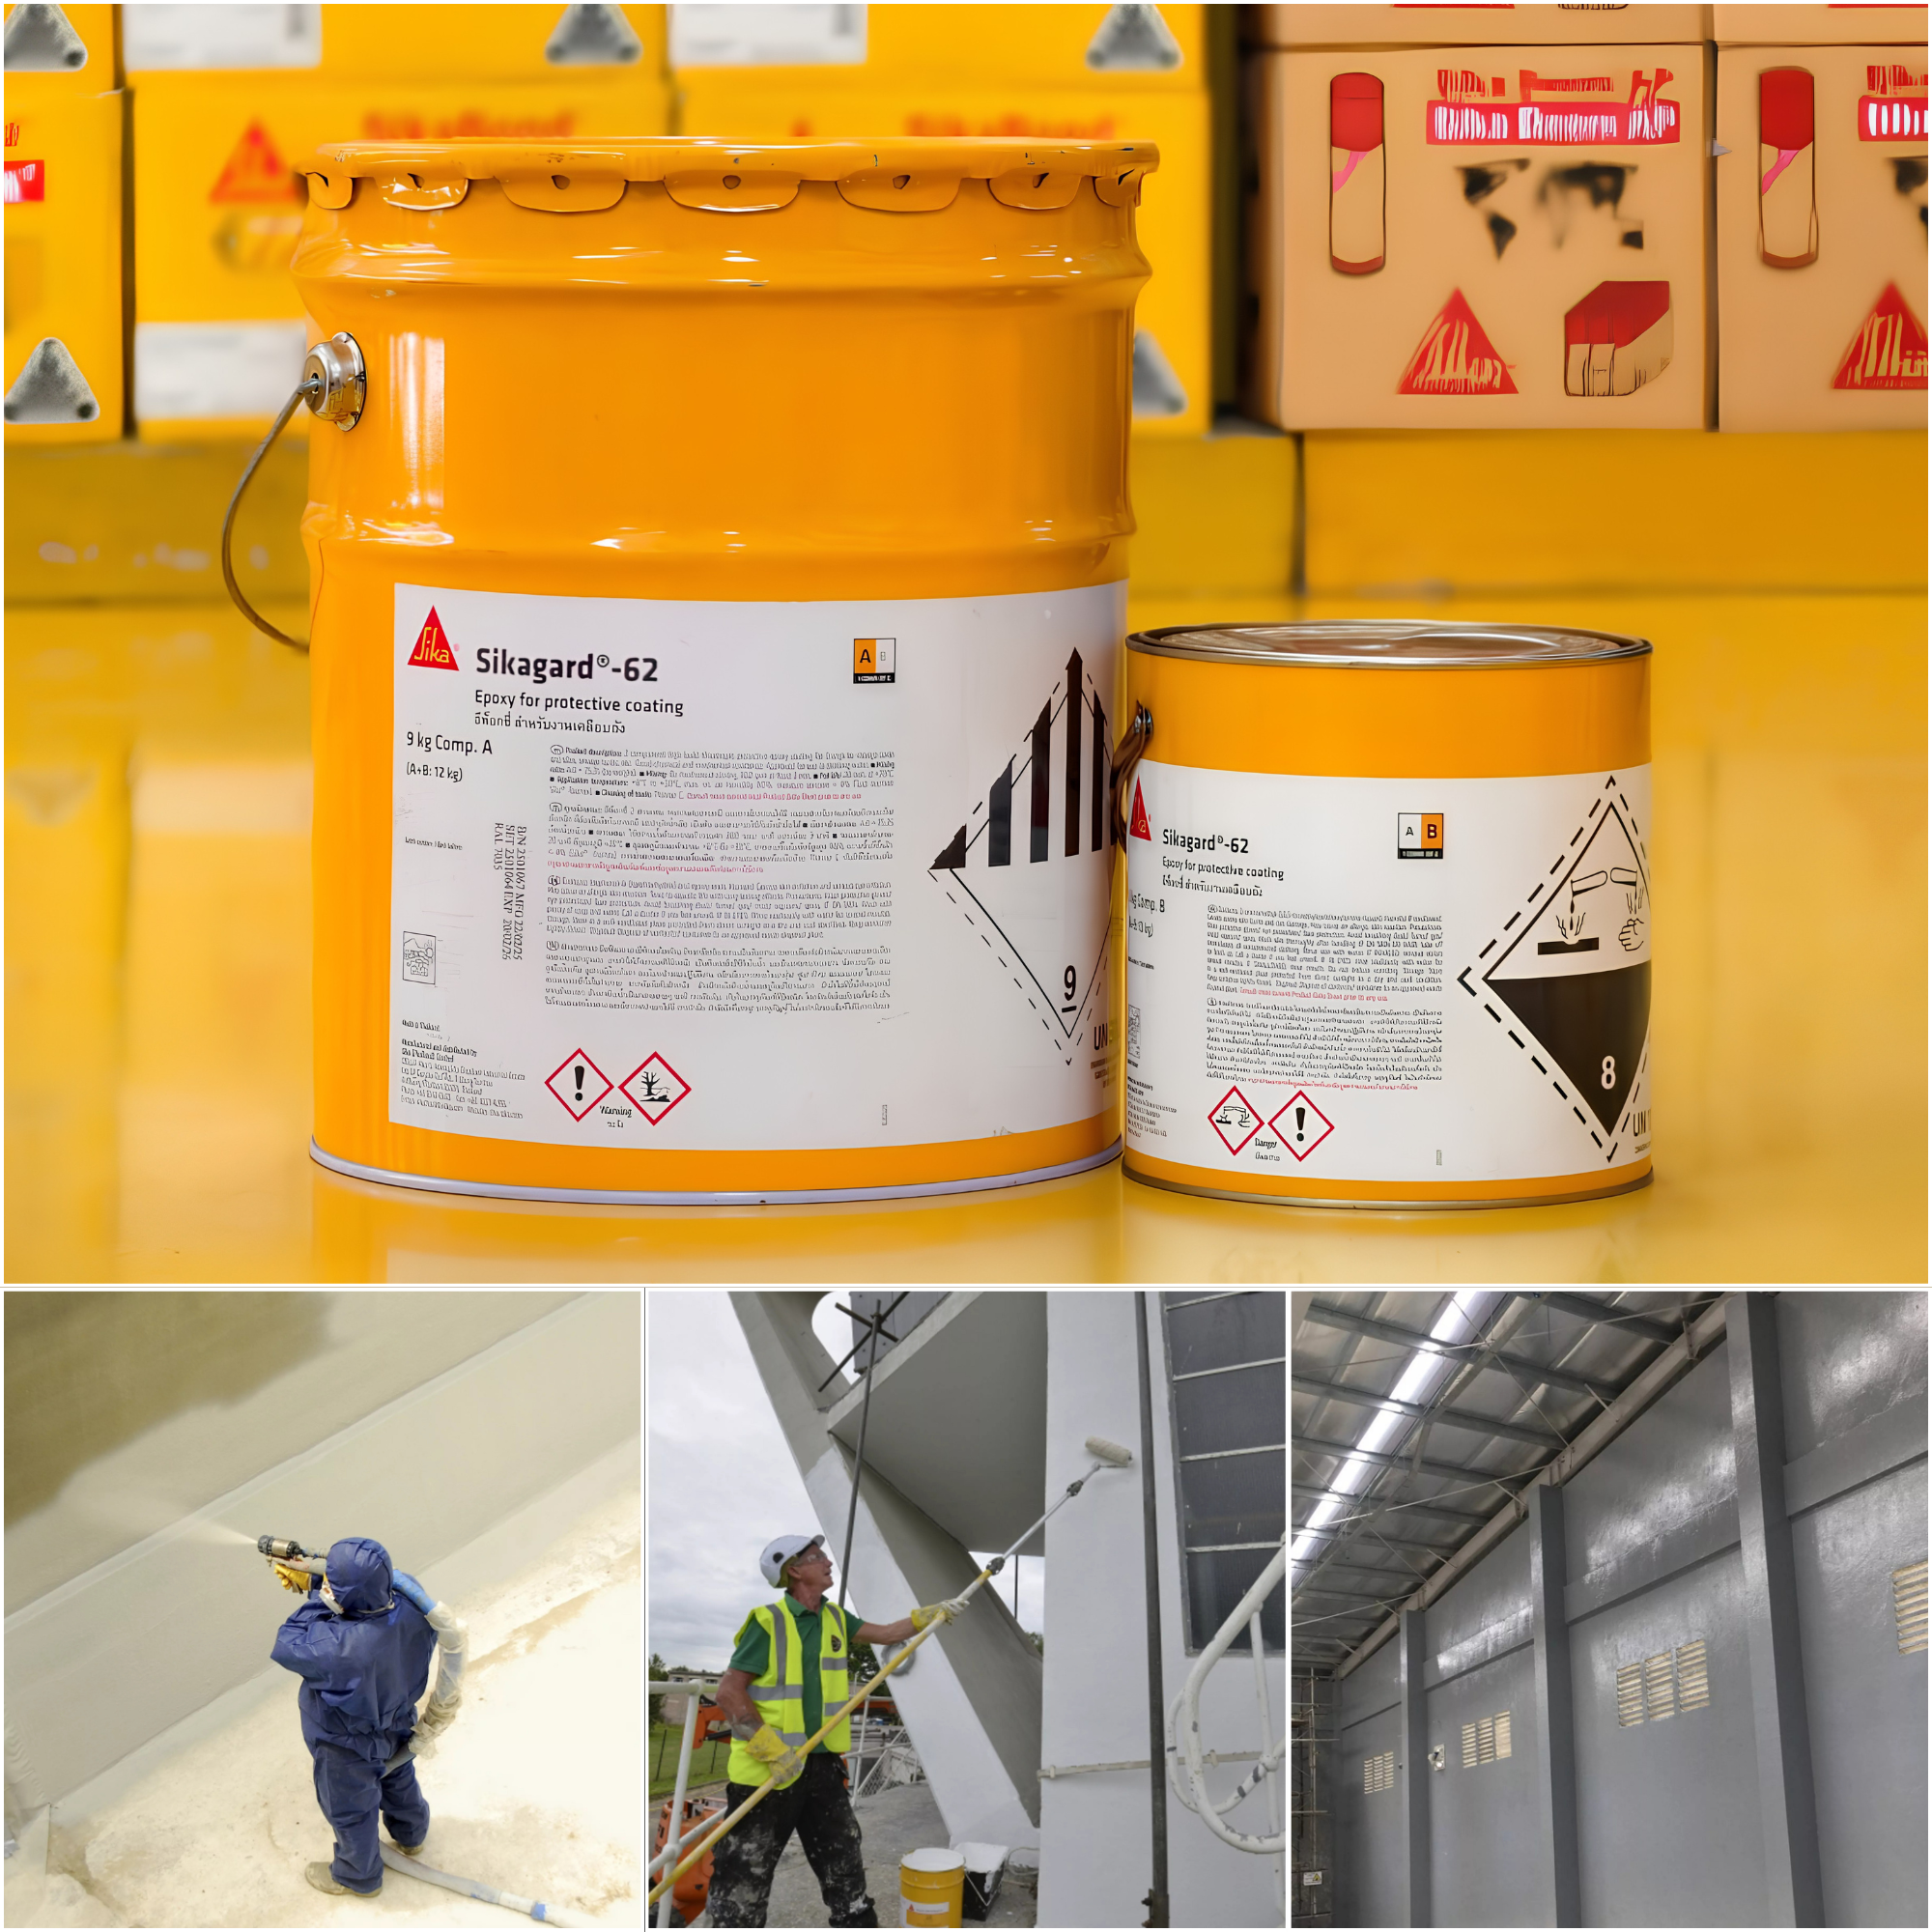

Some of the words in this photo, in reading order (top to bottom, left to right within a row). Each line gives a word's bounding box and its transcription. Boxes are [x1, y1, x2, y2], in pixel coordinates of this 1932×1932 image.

[413, 626, 450, 664] Sika
[859, 648, 871, 664] A
[476, 647, 659, 684] Sikagard®-62
[475, 690, 516, 709] Epoxy
[519, 693, 540, 708] for
[545, 696, 621, 711] protective
[625, 699, 684, 718] coating
[407, 731, 413, 746] 9
[417, 731, 432, 753] kg
[436, 734, 477, 756] Comp.
[482, 739, 493, 755] A
[406, 761, 432, 778] (A+B:
[434, 766, 445, 779] 12
[447, 767, 463, 783] kg)
[494, 822, 504, 845] RAL
[1406, 826, 1414, 837] A
[1427, 823, 1437, 838] B
[516, 847, 526, 890] 2501067
[1184, 859, 1196, 871] for
[1198, 864, 1243, 876] protective
[1246, 867, 1285, 881] coating
[1064, 964, 1077, 1002] 9
[1094, 1022, 1108, 1051] UN
[1601, 1055, 1616, 1091] 8
[599, 1105, 633, 1118] Warning
